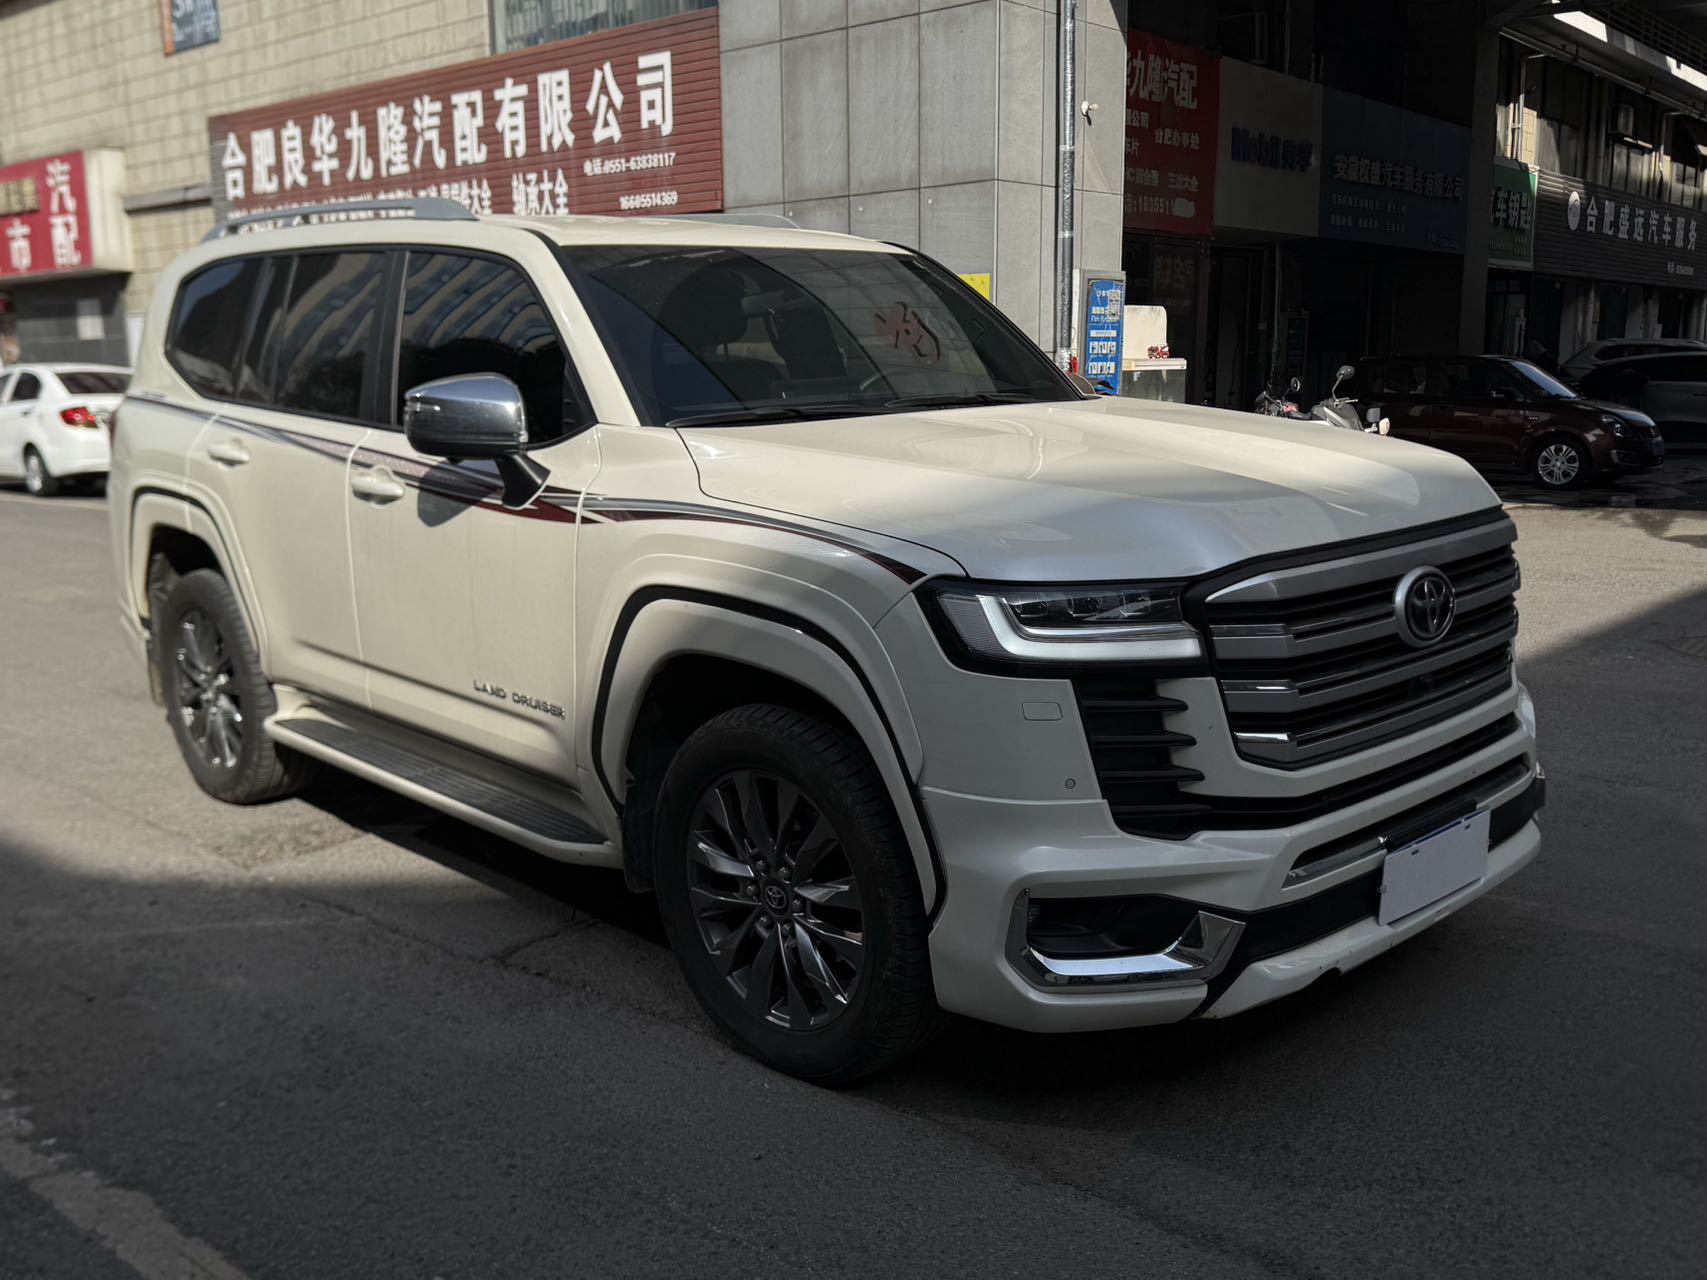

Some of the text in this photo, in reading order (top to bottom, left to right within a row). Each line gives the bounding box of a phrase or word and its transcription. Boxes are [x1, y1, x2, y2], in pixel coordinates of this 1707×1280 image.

[1127, 49, 1198, 110] 九隆汽配
[222, 50, 674, 201] 合肥良华九隆汽配有限公司
[1586, 195, 1698, 251] 合肥盛远汽车服务
[473, 680, 566, 720] LAND CRUISER
